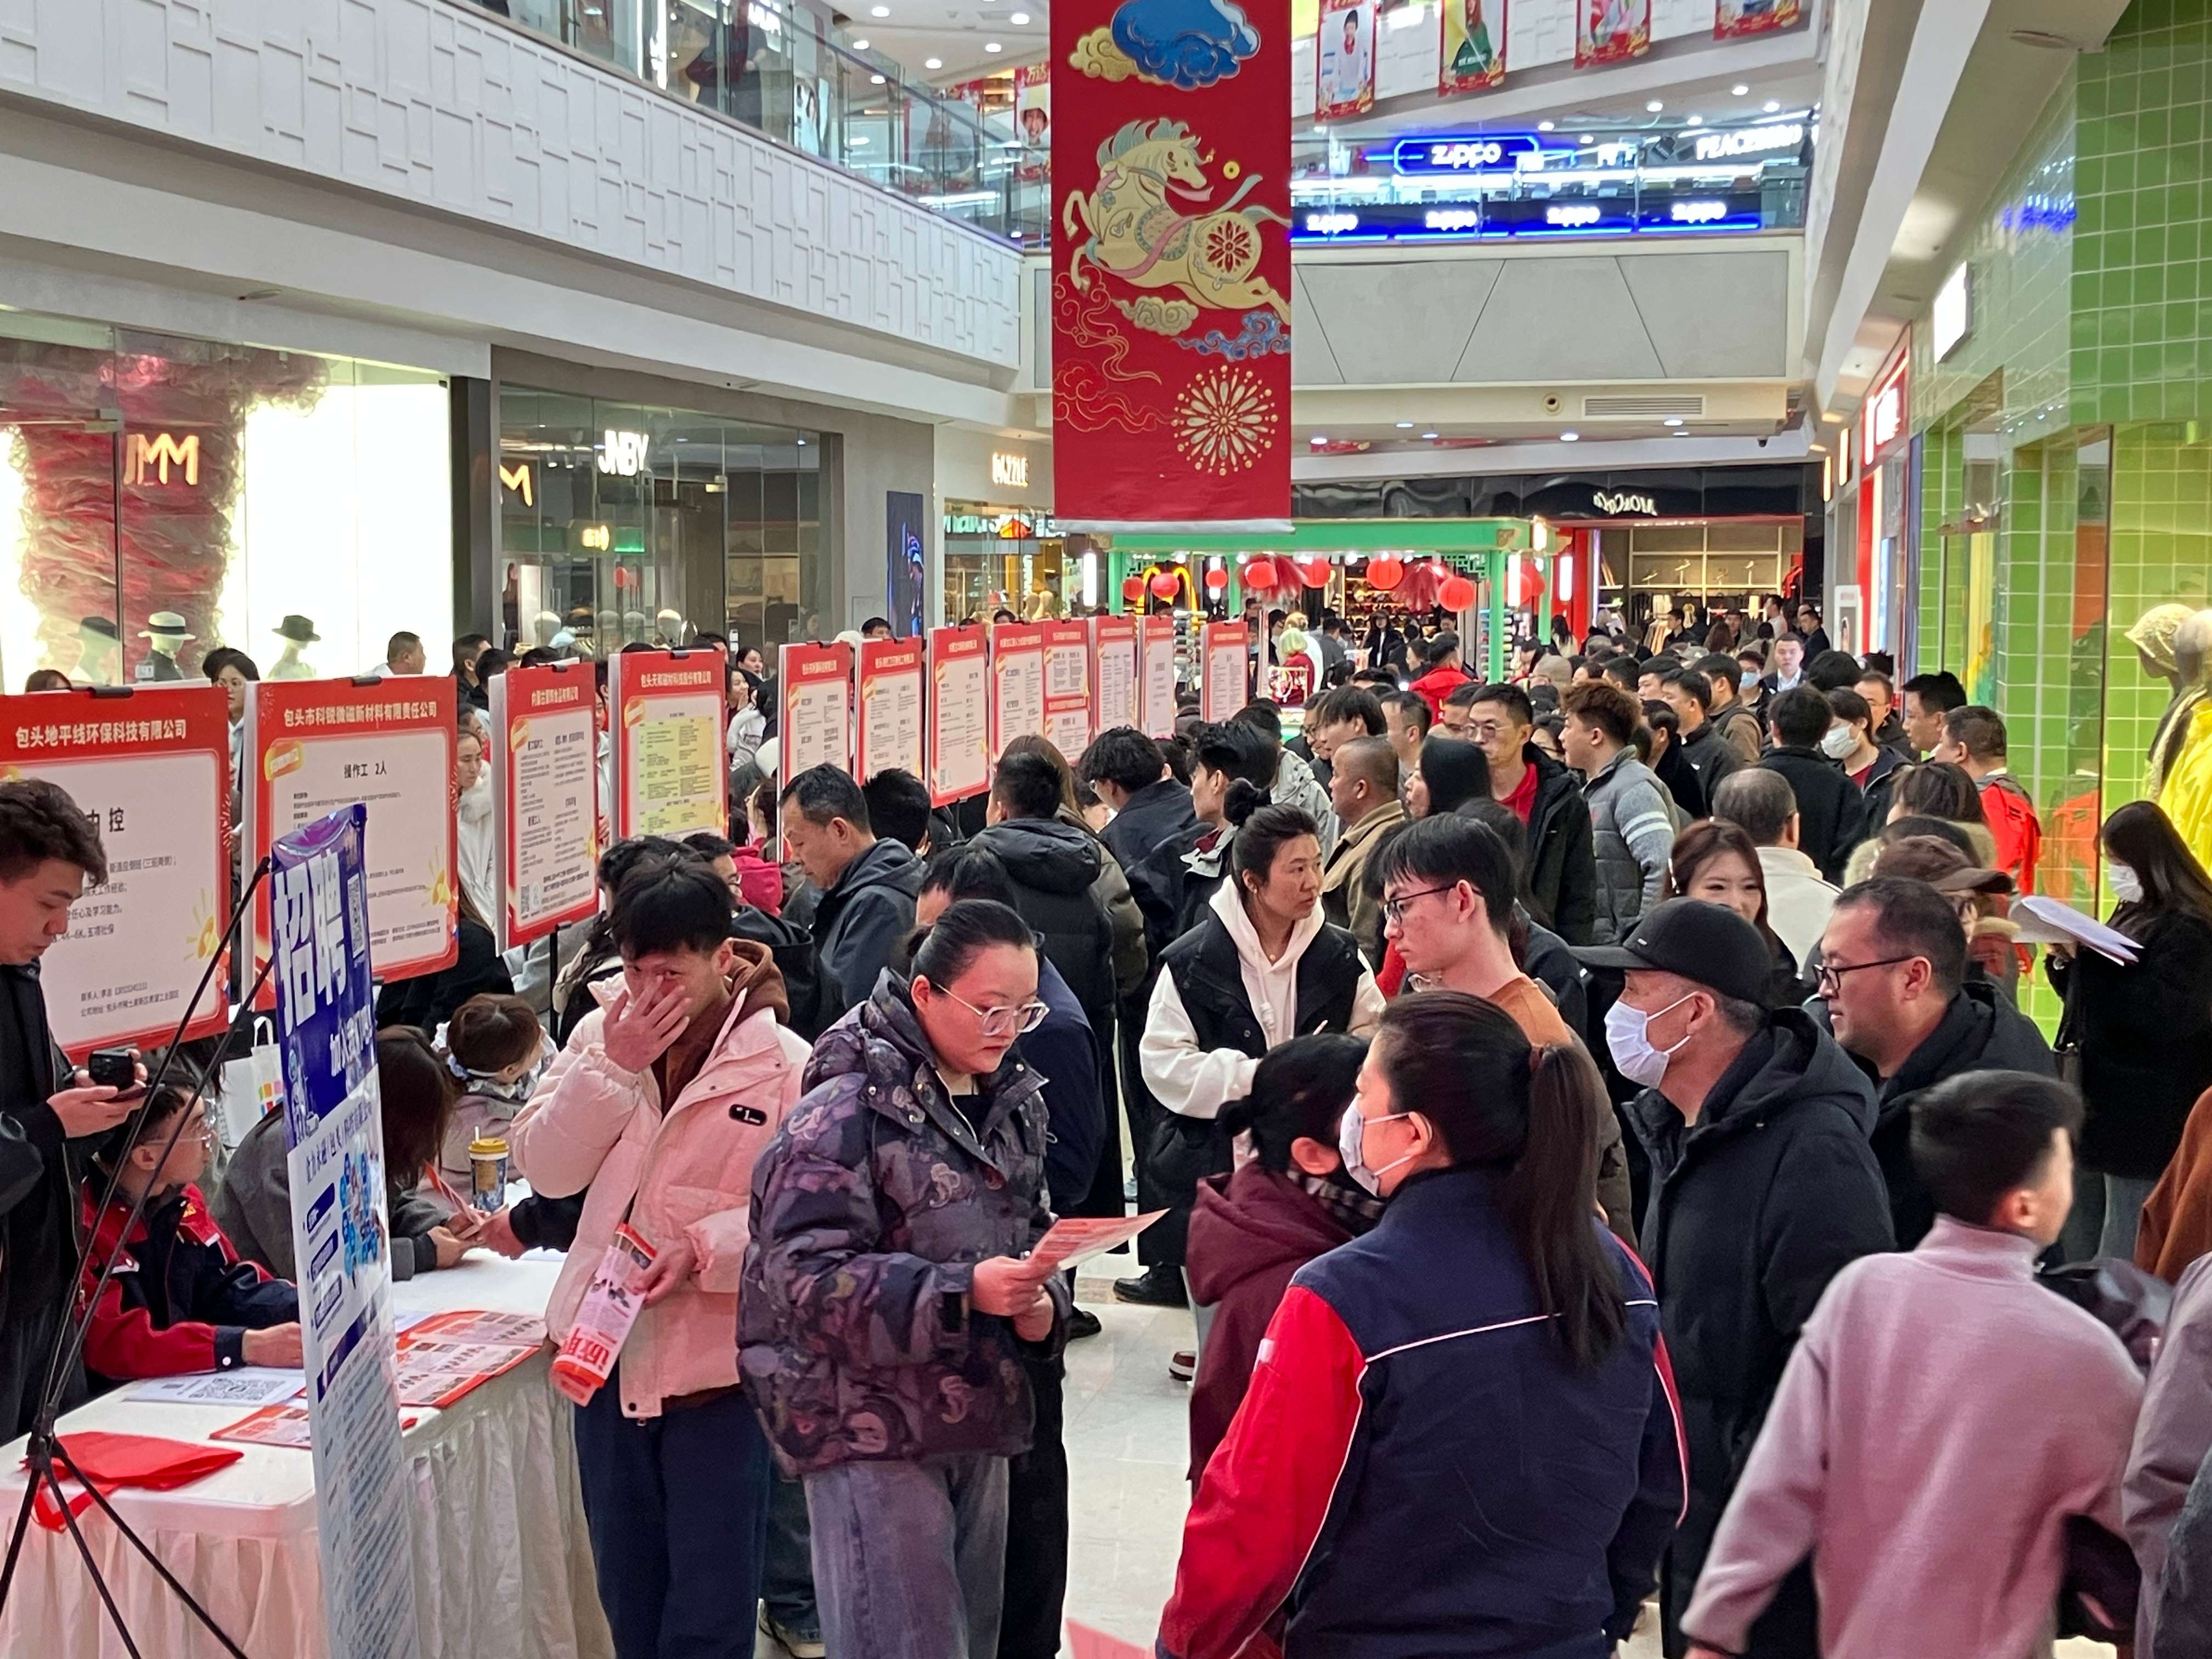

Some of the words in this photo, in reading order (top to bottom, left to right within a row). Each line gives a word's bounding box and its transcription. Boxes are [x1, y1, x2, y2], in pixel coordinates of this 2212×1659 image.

[597, 430, 650, 476] JNBY
[15, 719, 187, 748] 包头地平线环保科技有限公司
[274, 849, 346, 1037] 招聘
